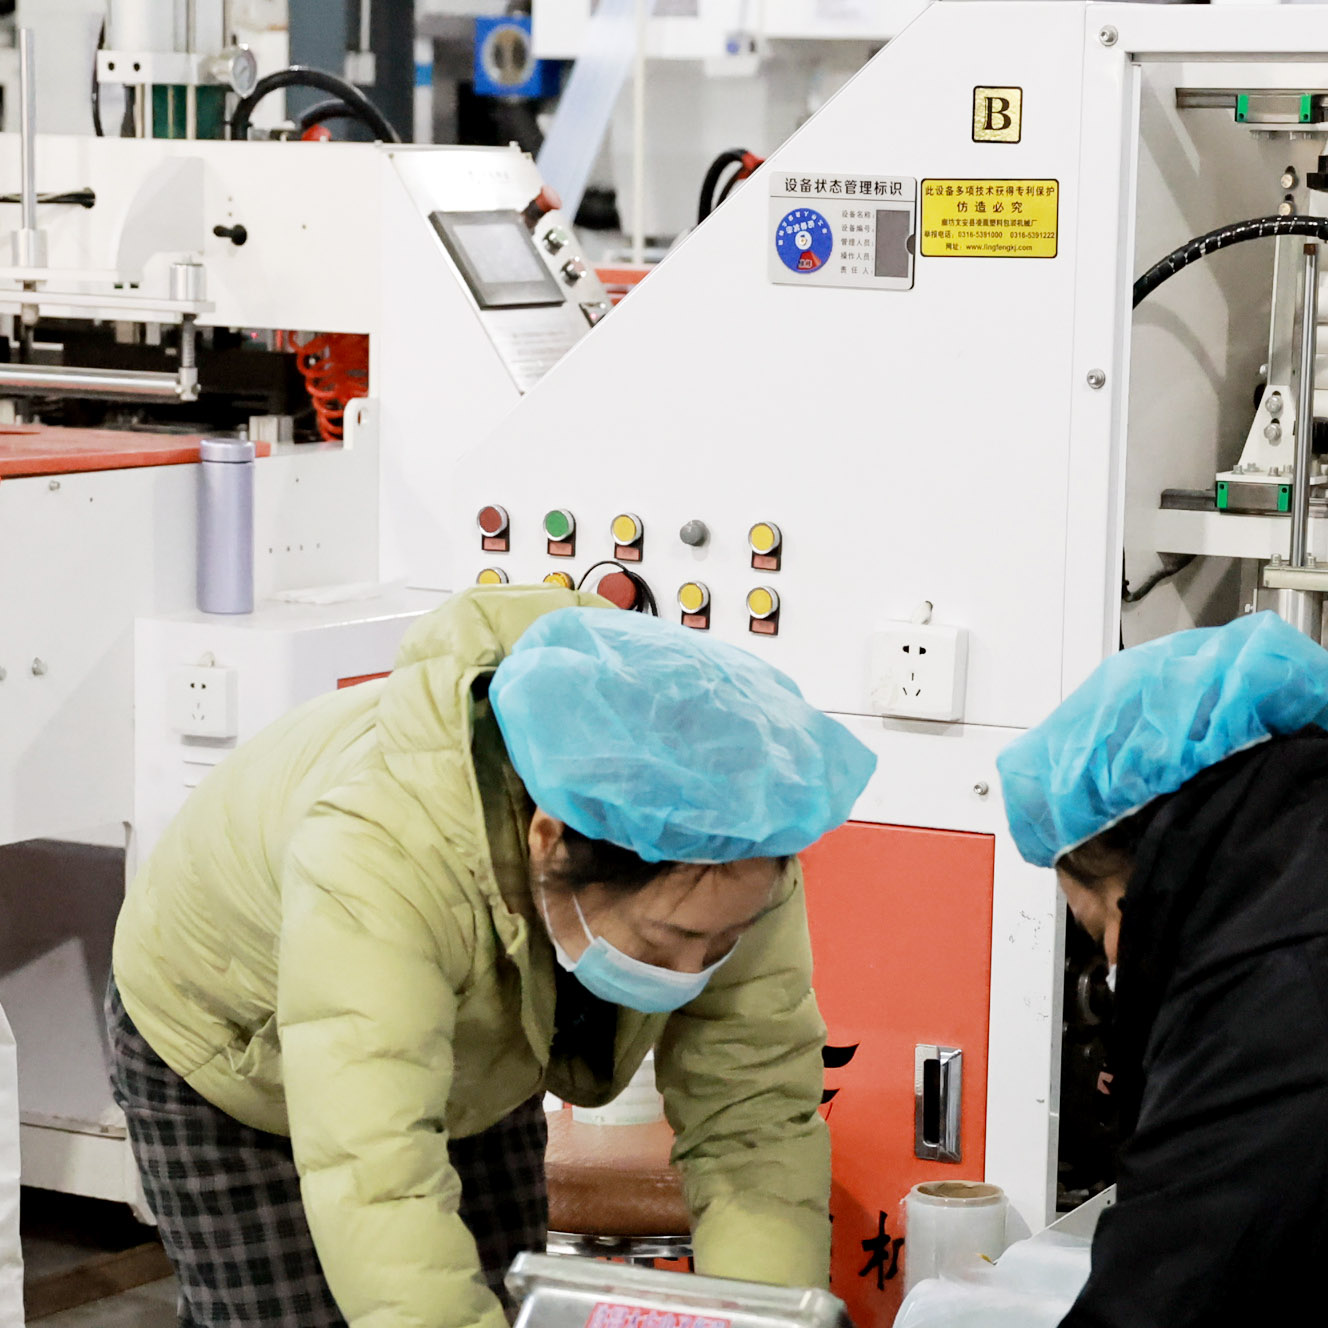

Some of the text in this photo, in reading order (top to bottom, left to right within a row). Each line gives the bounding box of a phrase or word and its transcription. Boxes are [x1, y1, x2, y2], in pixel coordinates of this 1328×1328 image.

[983, 96, 1012, 132] B
[784, 177, 903, 196] 设备状态管理标识
[924, 185, 1055, 197] 此设备多项技术获得专利保护
[956, 201, 1023, 214] 仿造必究
